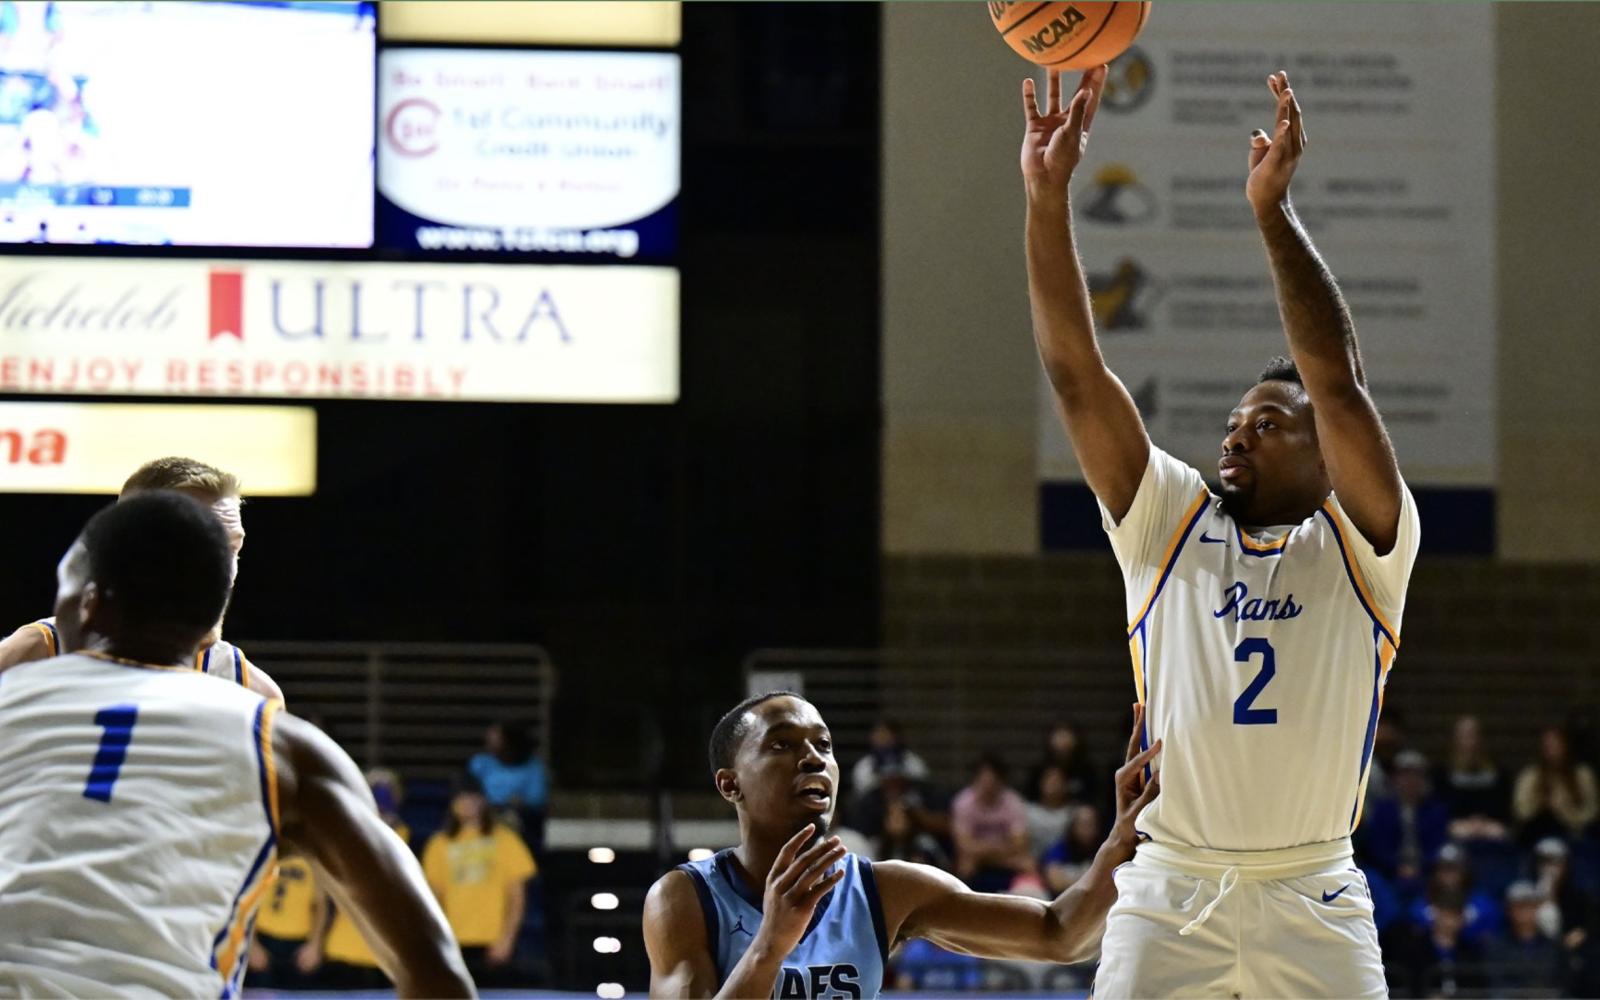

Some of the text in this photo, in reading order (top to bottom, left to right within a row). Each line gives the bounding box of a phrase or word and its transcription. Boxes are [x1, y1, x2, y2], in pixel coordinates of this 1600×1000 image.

[1022, 6, 1086, 54] NCAA
[501, 106, 670, 138] Community
[475, 140, 549, 158] Credit
[0, 270, 573, 343] ichelob ULTRA
[0, 356, 467, 390] ENJOY RESPONSIBLY
[1214, 581, 1303, 623] Rams
[1233, 637, 1278, 725] 2
[82, 703, 139, 804] 1
